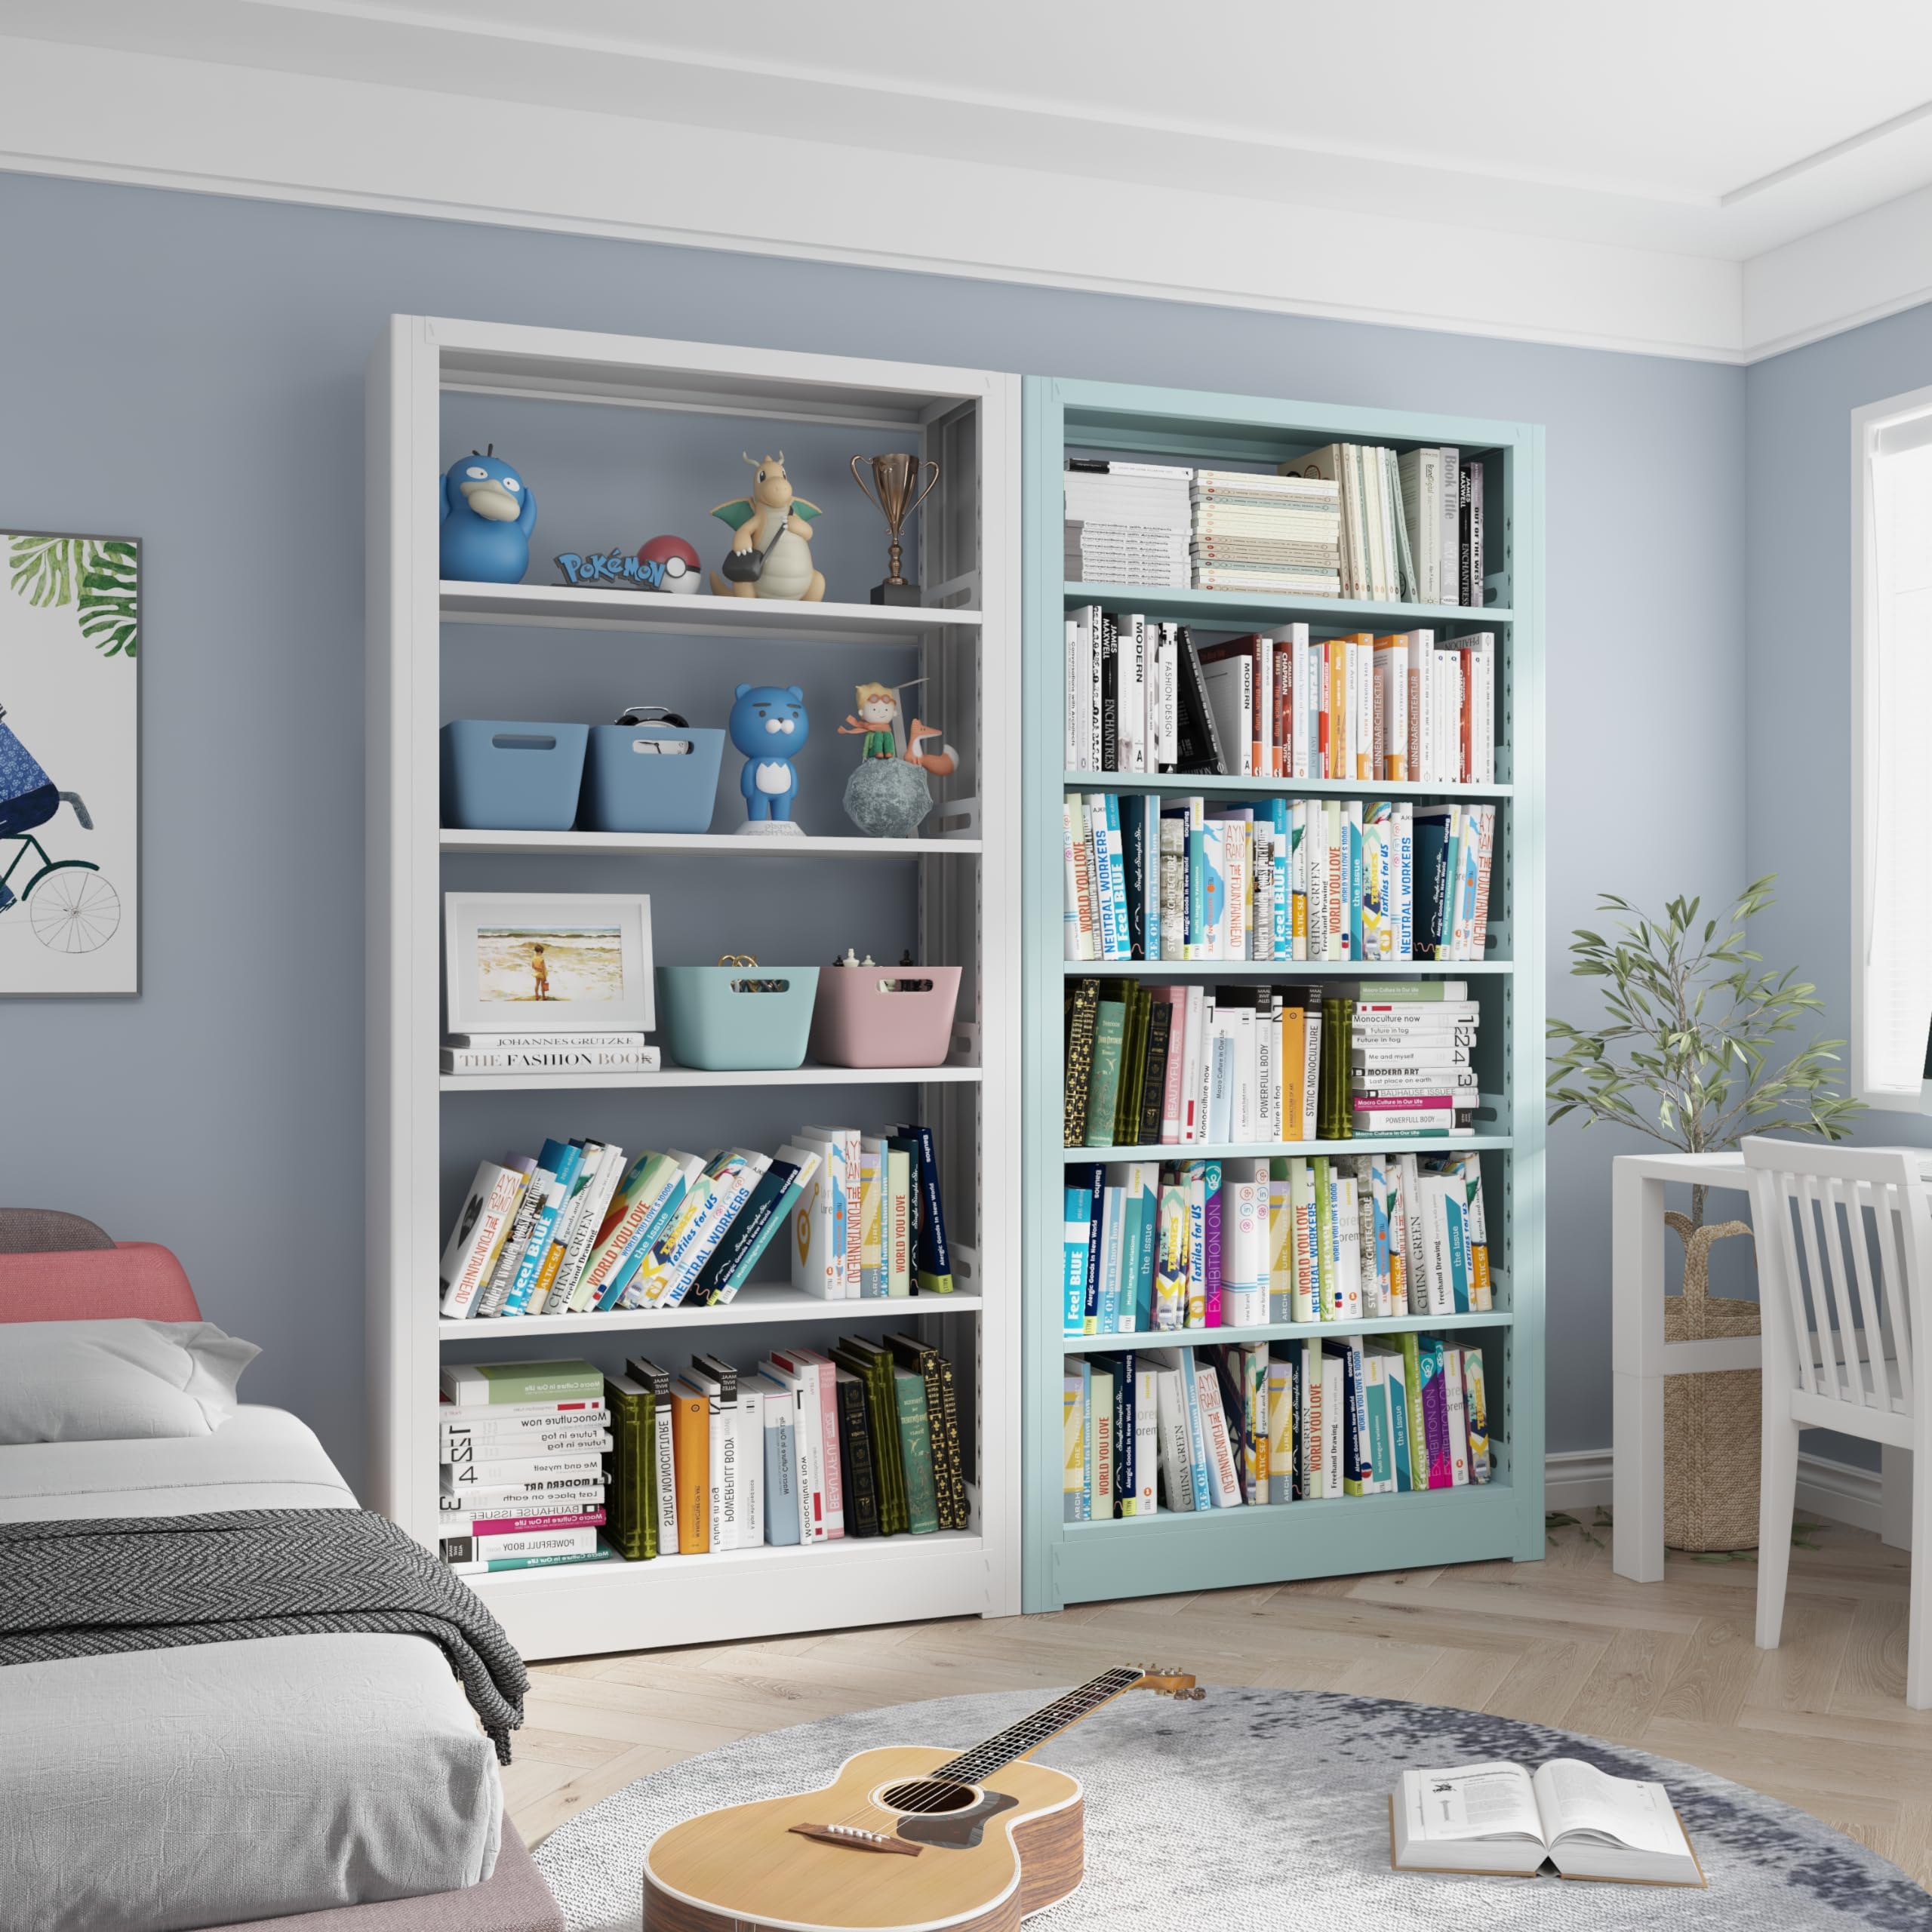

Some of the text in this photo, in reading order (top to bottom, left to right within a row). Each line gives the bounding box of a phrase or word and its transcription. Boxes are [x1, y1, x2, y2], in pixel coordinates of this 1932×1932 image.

[1444, 455, 1457, 519] Book Title
[1473, 528, 1480, 537] OF
[1460, 543, 1470, 606] ENCHANTRESS
[1102, 618, 1111, 659] MAXWELL
[1164, 661, 1173, 737] FASHION DESIGN
[1374, 675, 1383, 767] INNENARCHITEKTUR
[1411, 675, 1420, 767] INNENARCHITEKTUR
[1105, 699, 1115, 769] ENCHANTRESS
[1227, 825, 1244, 840] AYN
[1074, 841, 1092, 932] WORLD YOU LOVE
[1097, 830, 1115, 954] NEUTRAL WORKERS
[1183, 888, 1190, 896] In
[1230, 865, 1241, 875] THE
[1329, 847, 1340, 934] WORLD YOU LOVE
[1352, 859, 1361, 884] issue
[1380, 860, 1389, 875] for
[1380, 878, 1389, 917] Textiles
[1401, 838, 1411, 953] NEUTRAL WORKERS
[1112, 864, 1128, 941] Feel BLUE
[1231, 877, 1242, 947] FOUNTAINHEAD
[1311, 862, 1320, 954] CHINA GREEN
[497, 1036, 634, 1047] JOHANNES GRÜTZKE
[1354, 1014, 1401, 1023] Monoculture
[460, 1052, 652, 1067] THE FASHION BOOK
[1168, 1053, 1179, 1118] BEAUTYFUL
[1260, 1044, 1269, 1118] POWERFULL BODY
[1305, 1026, 1318, 1116] STATIC MONOCULTURE
[1384, 1078, 1402, 1086] place
[1396, 1053, 1414, 1061] myself
[1199, 1084, 1209, 1138] Monoculture
[1381, 1088, 1455, 1097] BAUHAUSE ISSUEE
[489, 1192, 512, 1214] RAND
[497, 1174, 519, 1196] AYN
[485, 1216, 500, 1230] THE
[587, 1200, 651, 1287] WORLD YOU LOVE
[635, 1213, 668, 1260] the issue
[667, 1231, 697, 1266] Textiles
[692, 1214, 707, 1230] for
[670, 1188, 749, 1301] NEUTRAL WORKERS
[1141, 1224, 1152, 1274] the issue
[1297, 1206, 1311, 1295] WORLD YOU LOVE
[1452, 1226, 1461, 1247] issue
[455, 1229, 495, 1304] FOUNTAINHEAD
[512, 1217, 552, 1297] Feel BLUE
[549, 1210, 594, 1308] CHINA GREEN
[1068, 1251, 1082, 1320] Feel BLUE
[1208, 1204, 1220, 1312] EXHIBITION ON
[1411, 1217, 1428, 1309] CHINA GREEN
[1209, 1412, 1221, 1423] THE
[1310, 1383, 1321, 1472] WORLD YOU LOVE
[1212, 1423, 1235, 1494] FOUNTAINHEAD
